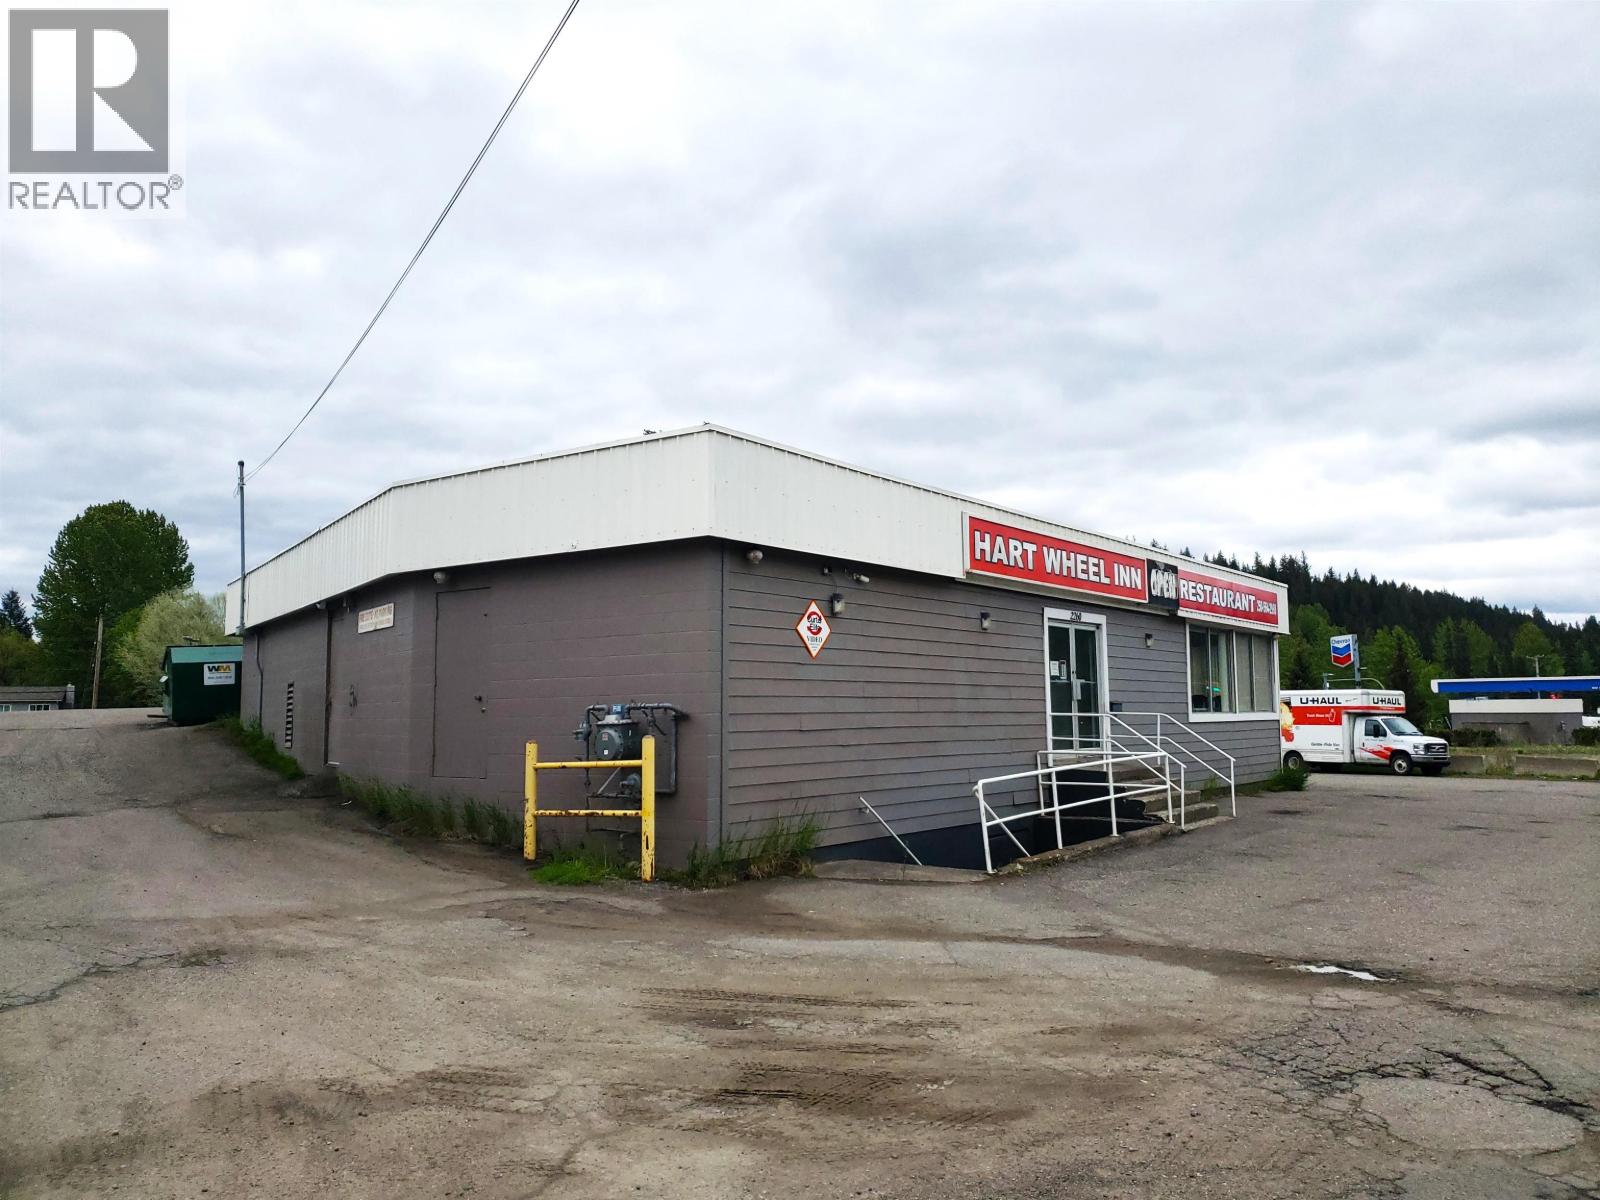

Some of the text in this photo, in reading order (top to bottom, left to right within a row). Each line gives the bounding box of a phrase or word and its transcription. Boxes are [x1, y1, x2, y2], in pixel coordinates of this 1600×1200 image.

[974, 530, 1142, 590] HART WHEEL INN
[1150, 568, 1179, 600] OPEN
[1180, 579, 1256, 613] RESTAURANT
